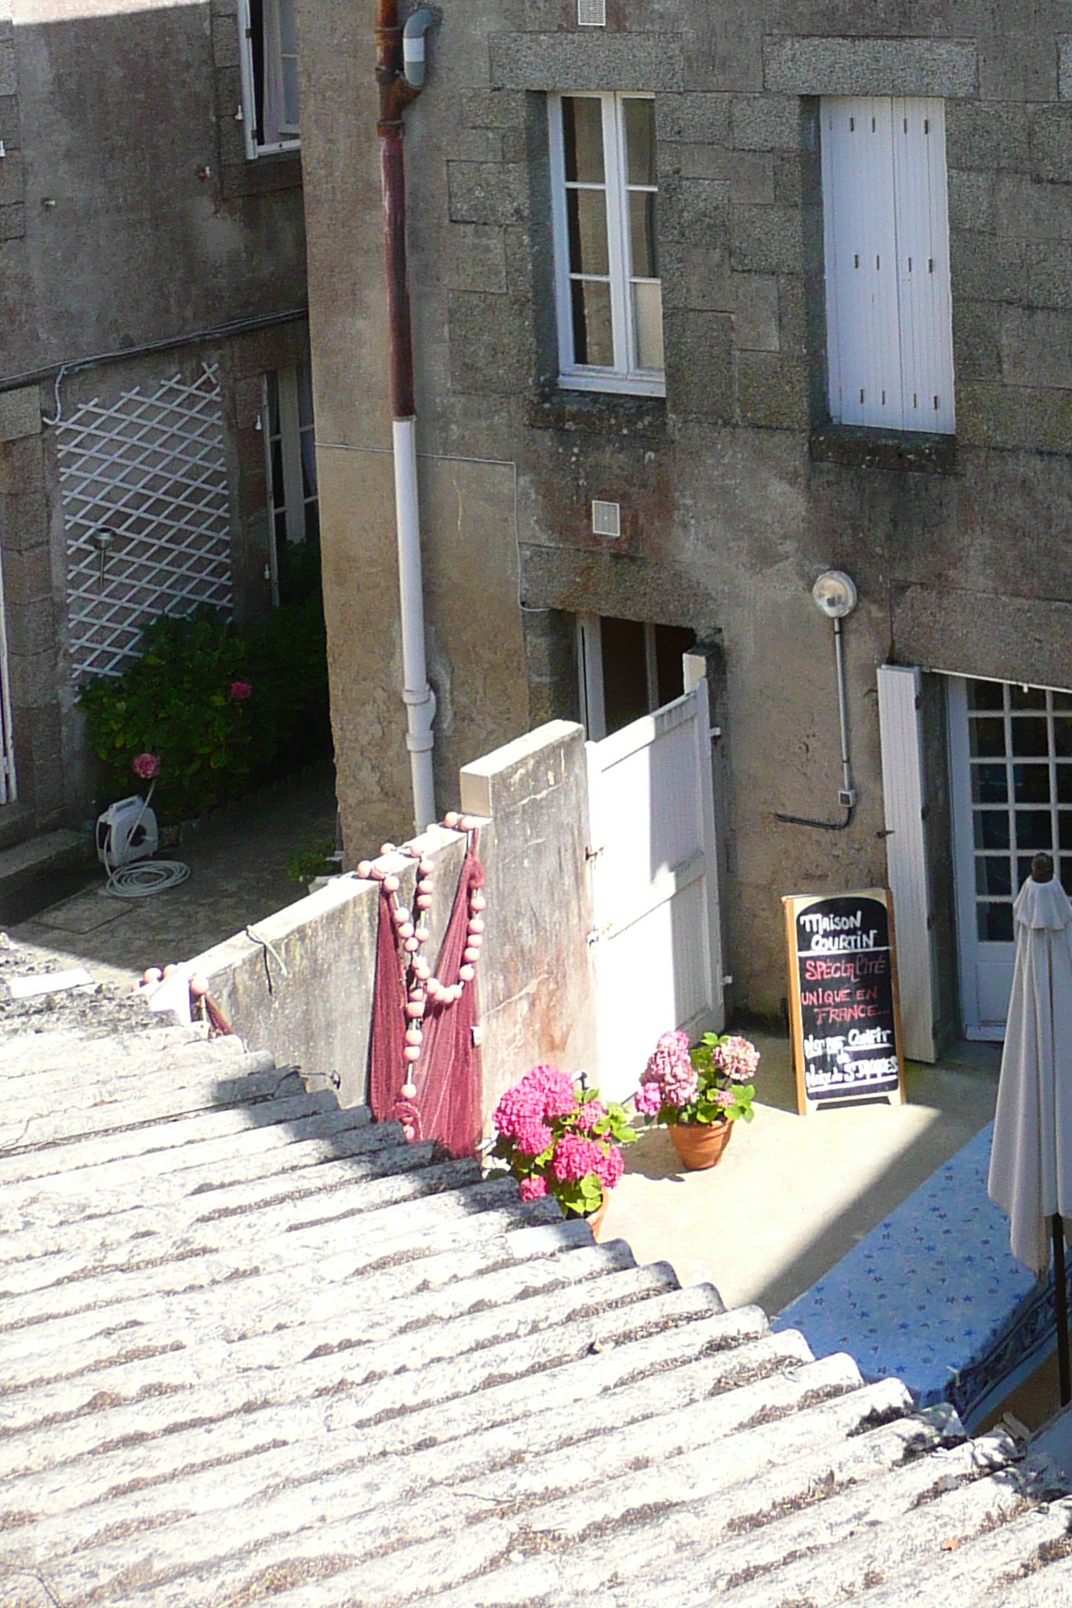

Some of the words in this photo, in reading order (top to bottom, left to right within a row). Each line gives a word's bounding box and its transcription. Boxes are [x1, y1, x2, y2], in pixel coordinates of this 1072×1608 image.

[800, 910, 862, 934] MAISON
[811, 930, 878, 951] COURTIN
[856, 987, 878, 1001] EN
